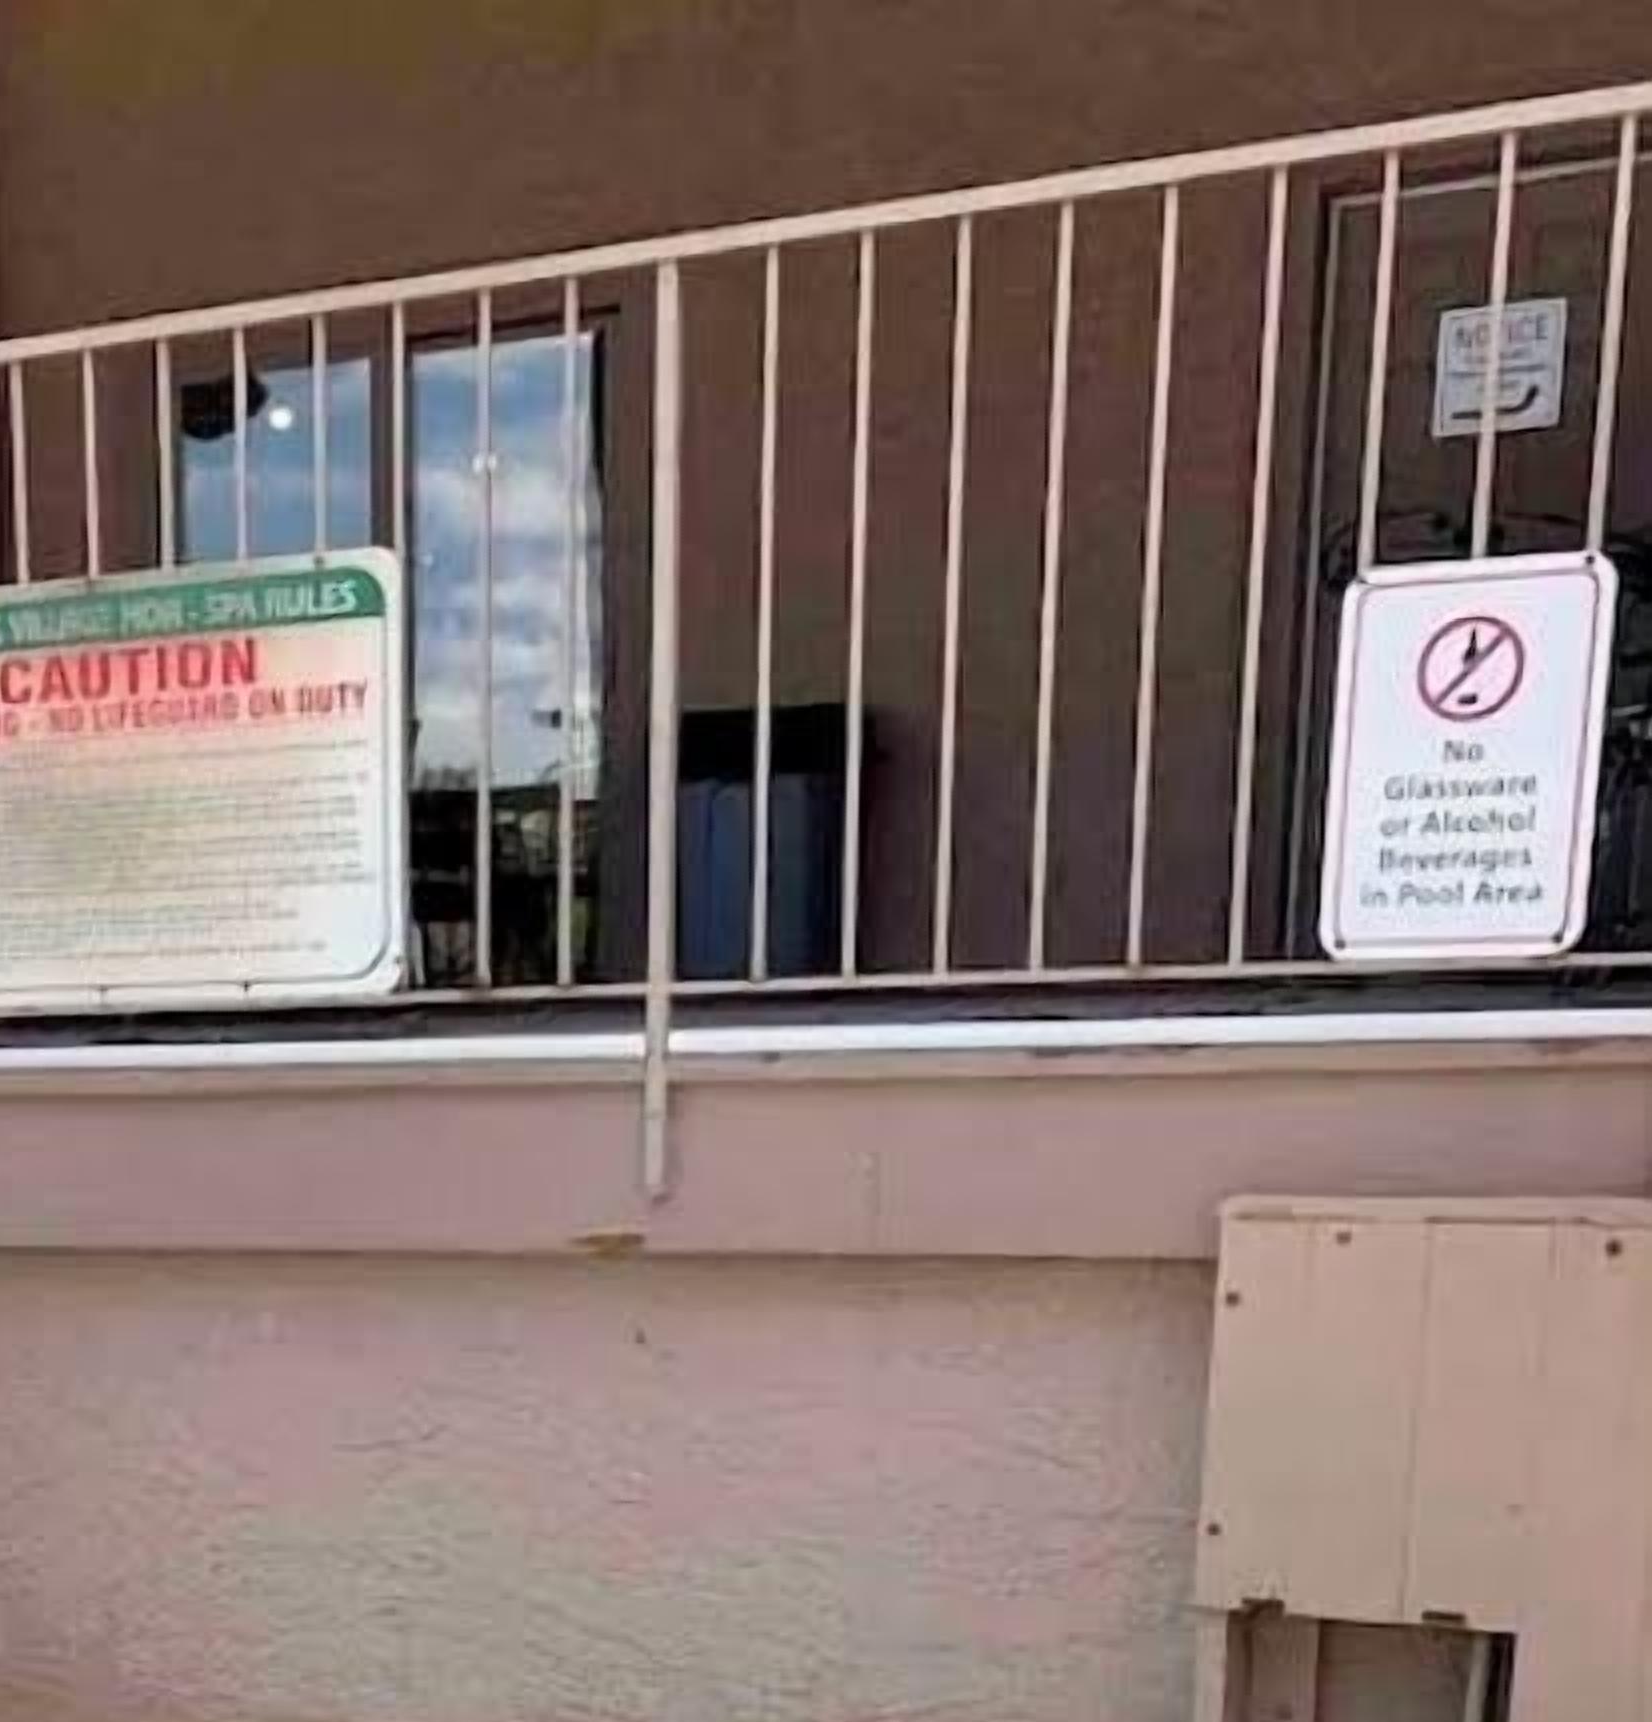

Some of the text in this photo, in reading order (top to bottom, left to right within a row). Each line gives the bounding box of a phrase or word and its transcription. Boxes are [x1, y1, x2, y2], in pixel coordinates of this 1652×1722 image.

[1454, 312, 1549, 348] NOICE
[203, 588, 257, 625] SPA
[264, 578, 357, 621] RULES
[0, 638, 257, 705] CAUTION
[49, 703, 85, 733] NO
[92, 690, 241, 733] LIFEGUARD
[248, 685, 287, 718] ON
[299, 677, 368, 713] DUTY
[1443, 739, 1484, 763] No
[1383, 774, 1537, 801] Glassware
[1379, 805, 1537, 837] or Alcohol
[1379, 847, 1533, 873] Beverages
[1399, 880, 1465, 907] Pool
[1473, 879, 1544, 905] Area
